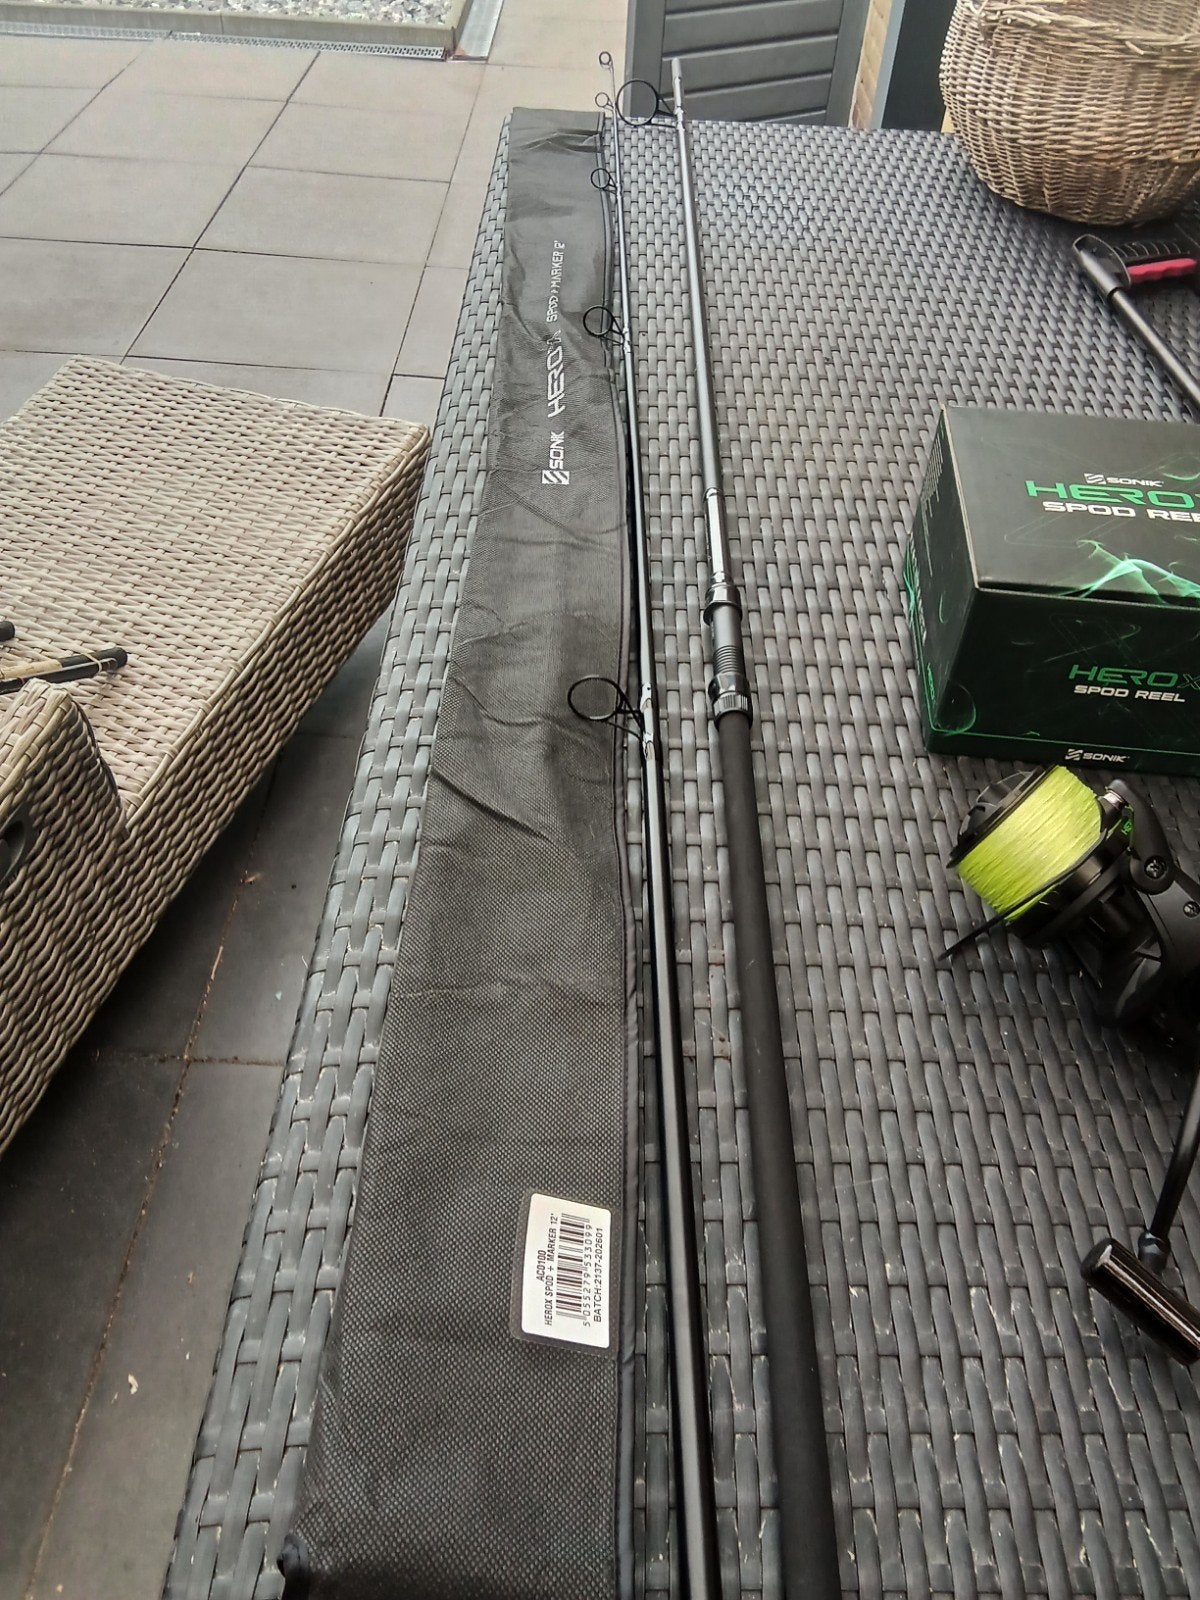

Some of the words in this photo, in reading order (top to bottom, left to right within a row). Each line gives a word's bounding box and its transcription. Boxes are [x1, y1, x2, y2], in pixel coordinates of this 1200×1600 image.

[550, 251, 564, 288] MARKER
[546, 295, 559, 322] SPOD
[1025, 480, 1200, 509] HERO
[1106, 477, 1163, 488] SONIK
[1042, 501, 1136, 518] SPOD
[1074, 685, 1129, 698] SPOD
[1134, 690, 1186, 702] REEL
[1082, 752, 1128, 763] SONIK
[547, 1228, 557, 1262] MARKER
[584, 1224, 593, 1267] 533099
[535, 1249, 547, 1282] AC0100
[593, 1227, 604, 1322] BATCH:2137-202601
[546, 1276, 554, 1297] SPOD
[583, 1273, 592, 1317] 055279
[544, 1298, 553, 1326] HEROX
